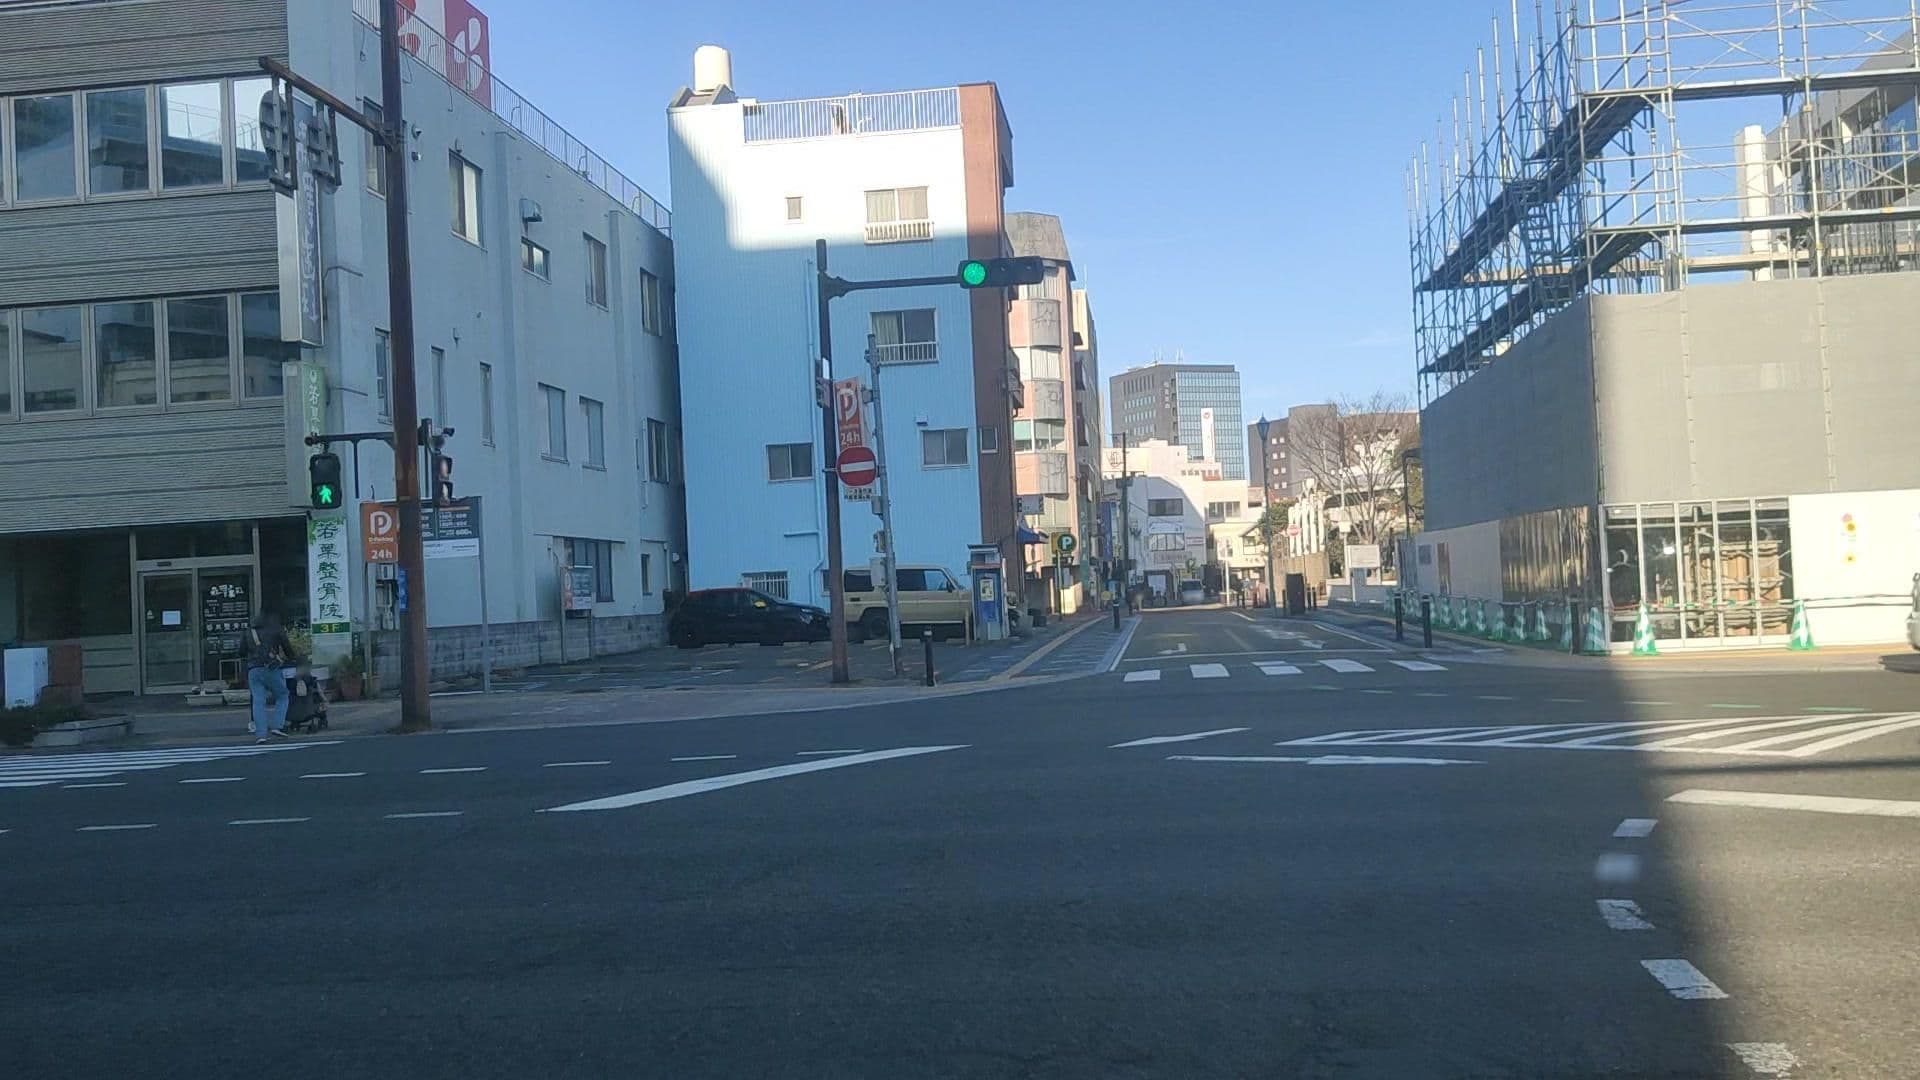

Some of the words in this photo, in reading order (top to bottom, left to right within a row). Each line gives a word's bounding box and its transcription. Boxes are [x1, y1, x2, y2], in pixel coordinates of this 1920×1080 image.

[840, 433, 860, 446] 24h
[370, 510, 392, 536] P
[1062, 536, 1072, 549] P
[371, 549, 392, 560] 24h
[320, 624, 341, 633] 3F
